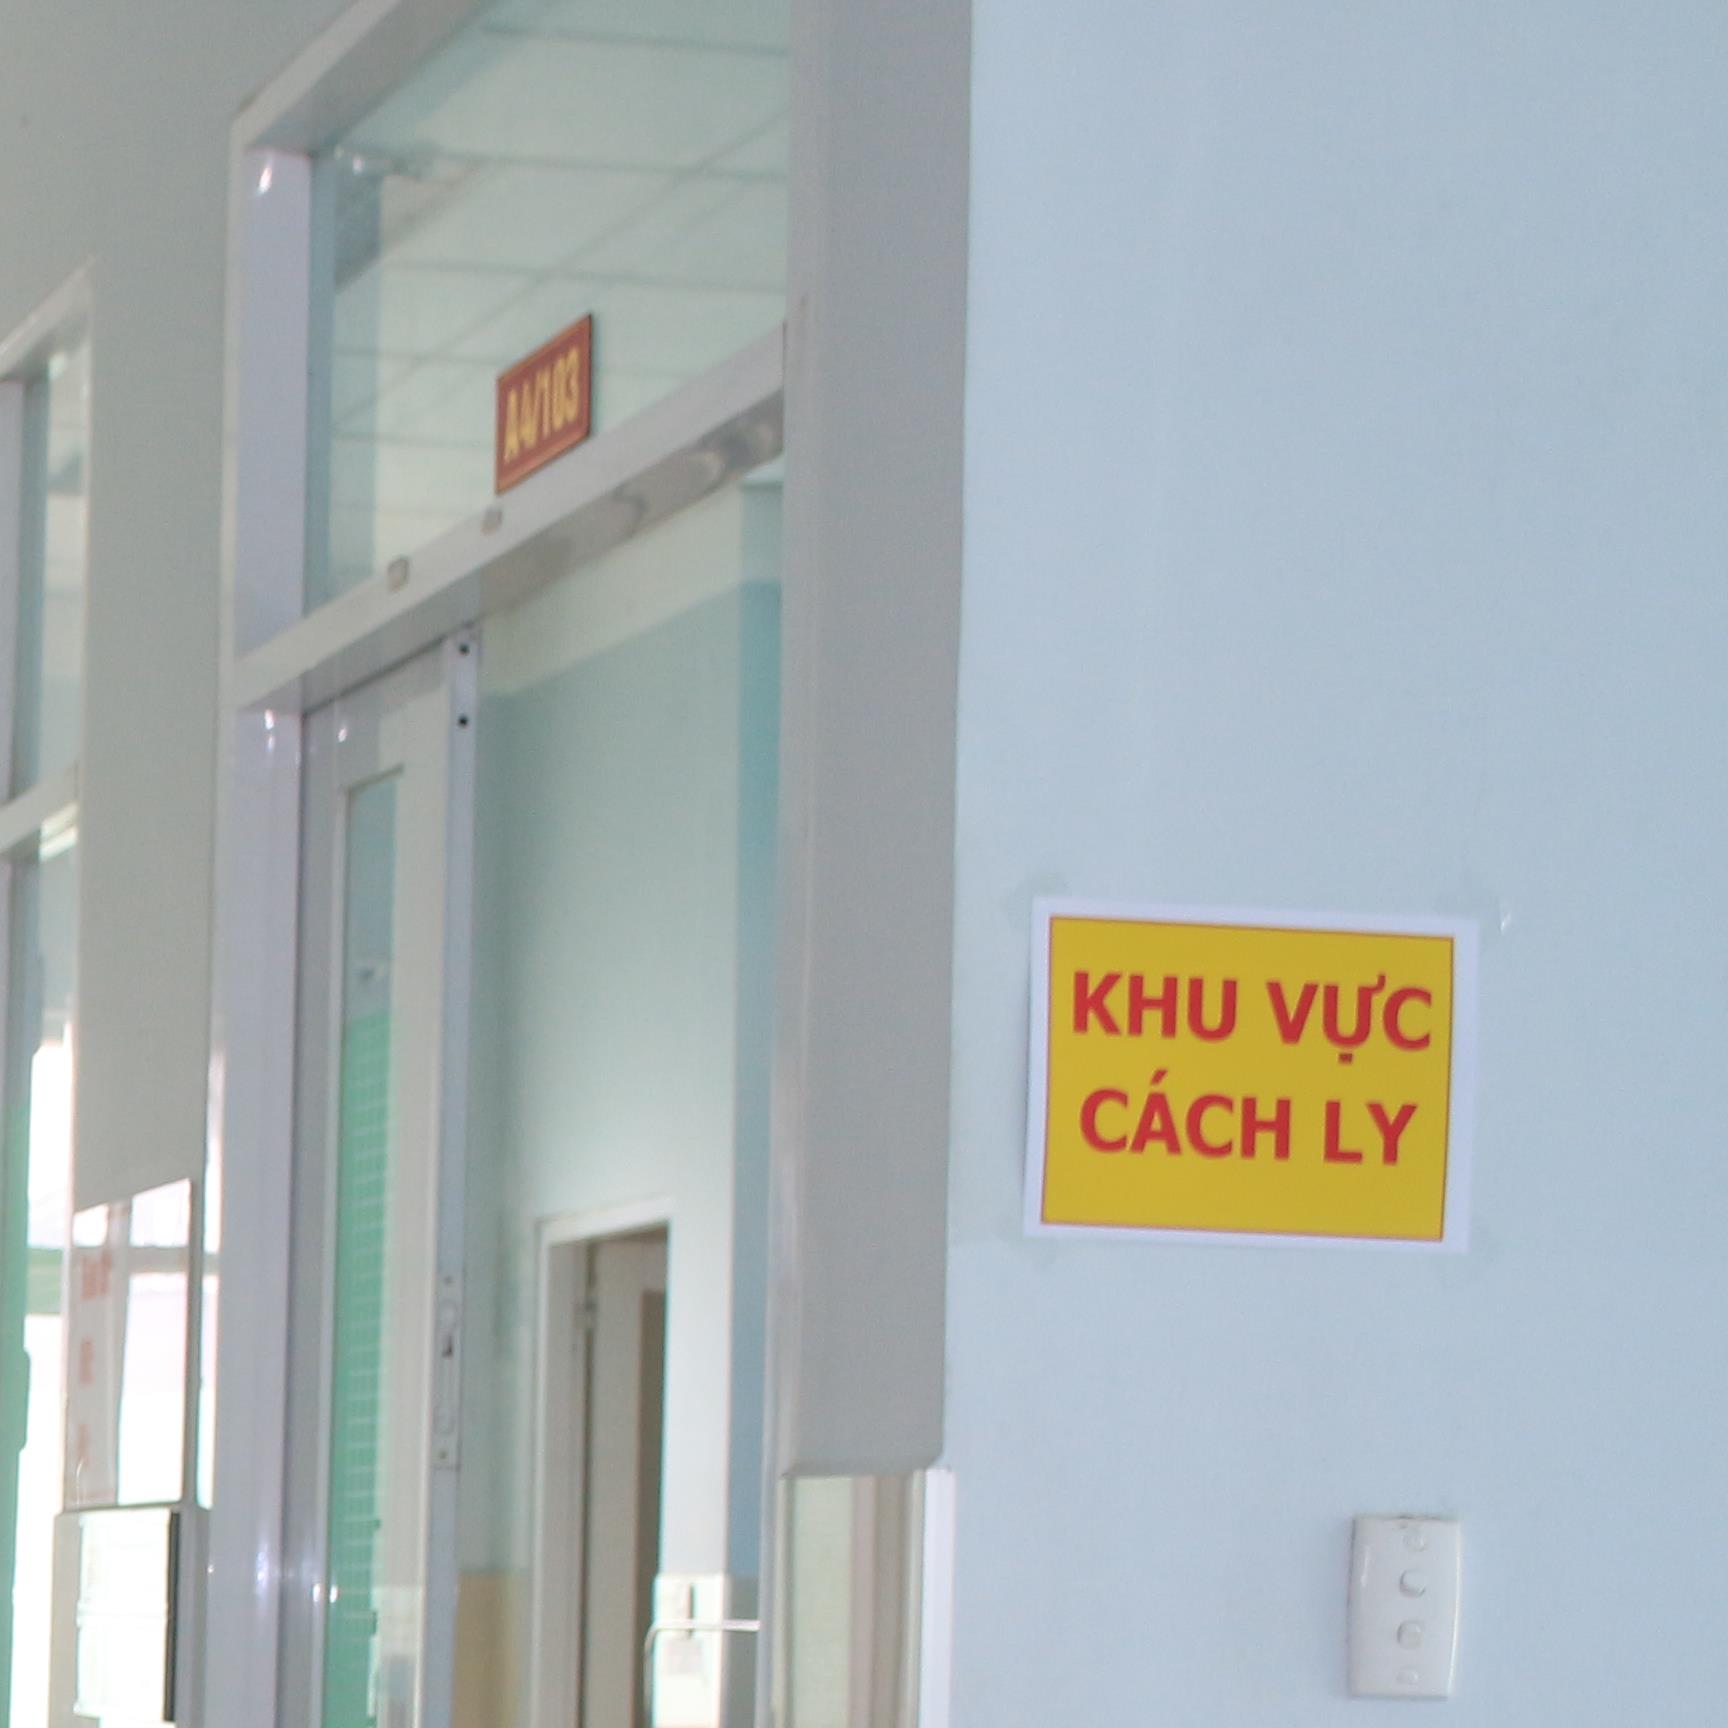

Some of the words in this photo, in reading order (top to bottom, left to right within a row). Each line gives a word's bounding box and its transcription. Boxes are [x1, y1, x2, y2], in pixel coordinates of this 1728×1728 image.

[1072, 970, 1239, 1042] KHU
[1266, 973, 1433, 1065] VỰC
[1079, 1069, 1293, 1160] CÁCH
[1322, 1100, 1419, 1166] LY
